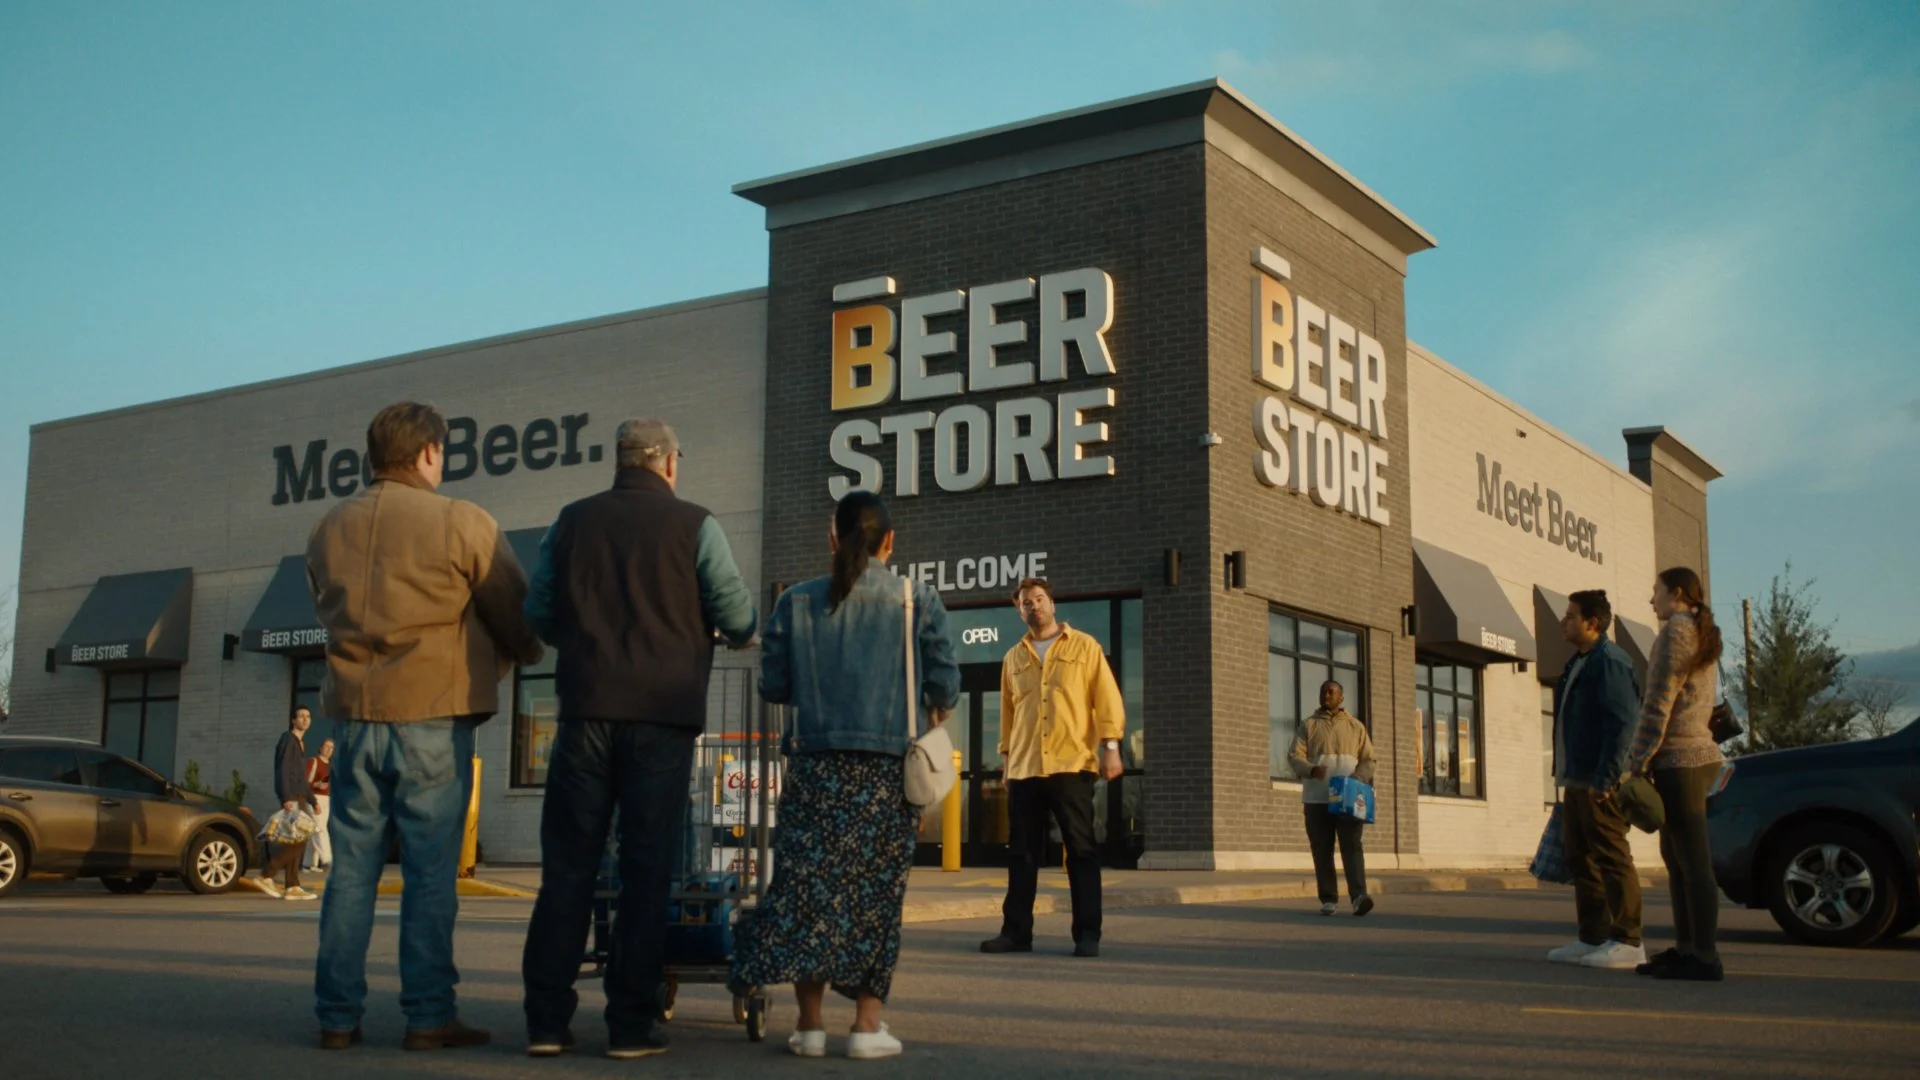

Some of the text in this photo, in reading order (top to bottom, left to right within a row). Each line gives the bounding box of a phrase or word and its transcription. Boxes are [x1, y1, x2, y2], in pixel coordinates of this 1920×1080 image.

[831, 267, 1116, 411] BEER
[1251, 246, 1388, 440] BEER
[271, 412, 603, 506] Me Beer.
[828, 387, 1115, 501] STORE
[1253, 396, 1390, 527] STORE
[1475, 451, 1603, 565] Meet Beer.
[71, 643, 129, 662] BEER STORE
[261, 628, 328, 649] BEER STORE
[962, 627, 999, 645] OPEN
[1481, 626, 1517, 656] BEER STORE
